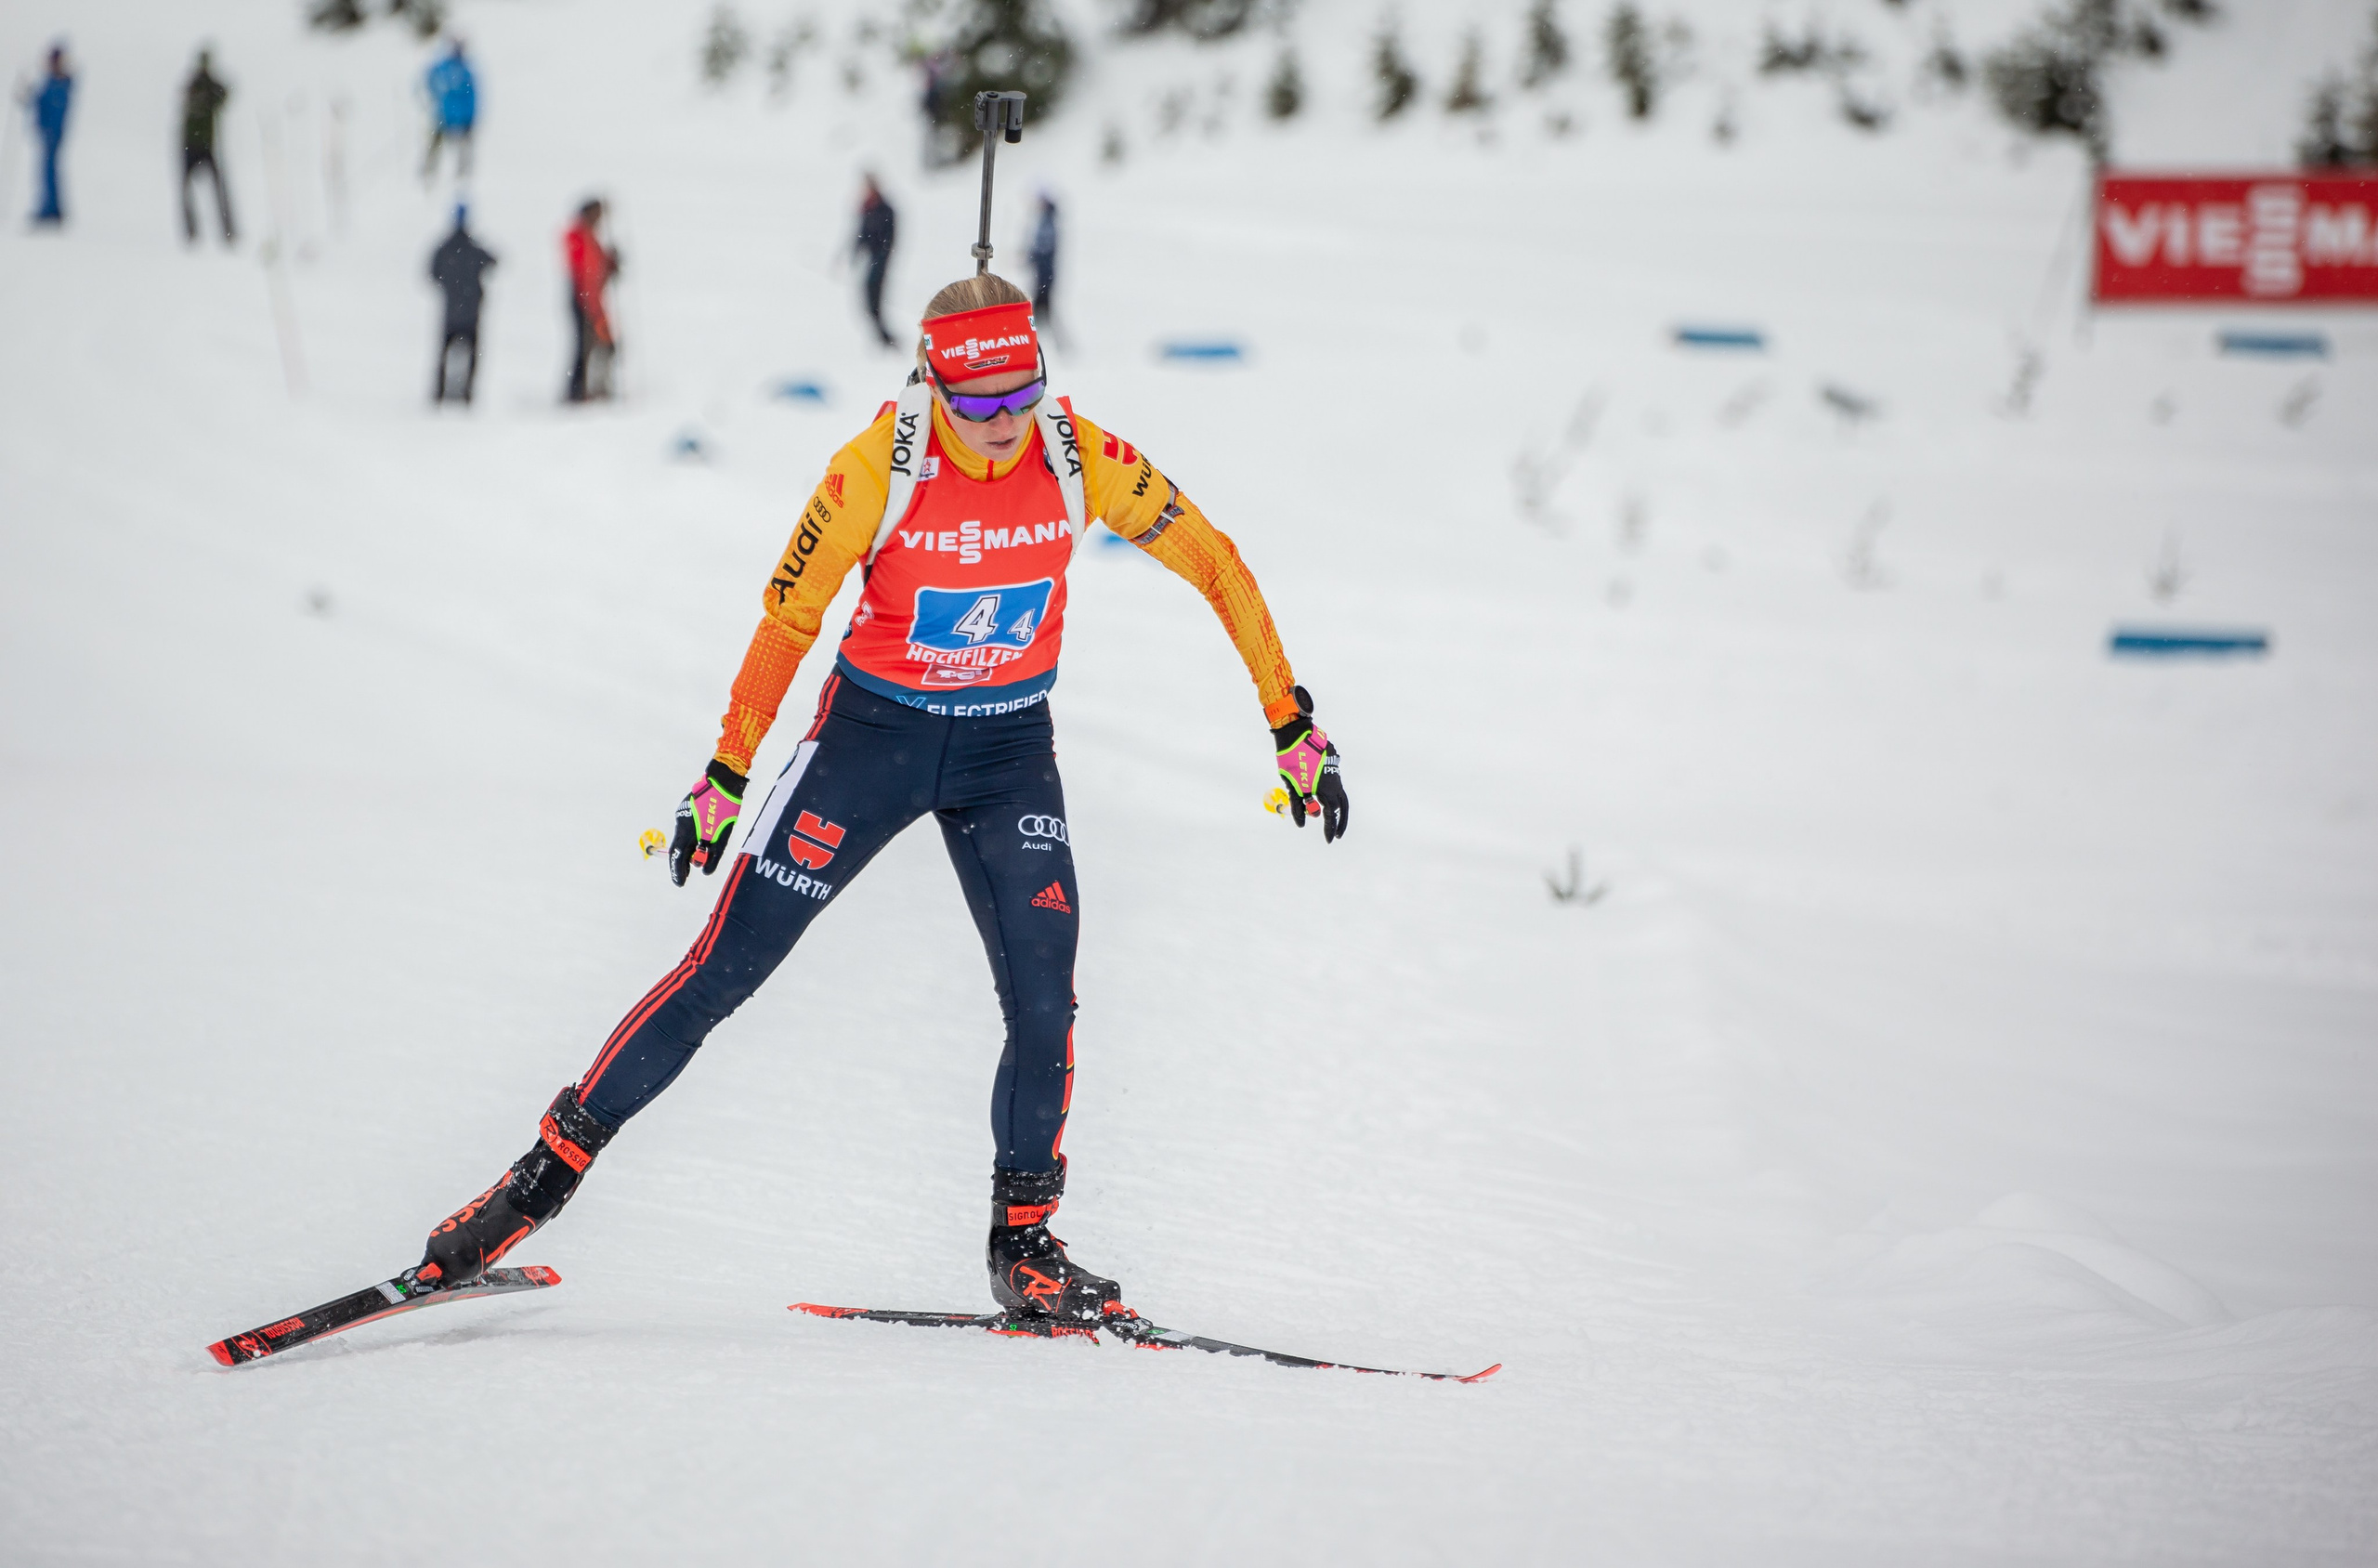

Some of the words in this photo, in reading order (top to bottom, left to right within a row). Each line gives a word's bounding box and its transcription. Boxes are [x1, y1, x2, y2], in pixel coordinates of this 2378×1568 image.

[2104, 185, 2378, 296] VIESSM
[941, 334, 1029, 359] VIESSMANN
[891, 412, 920, 477] JOKA
[1046, 413, 1083, 477] JOKA
[771, 512, 823, 607] Audi
[898, 519, 1072, 564] VIESSMANN
[951, 595, 1000, 645] 4
[1007, 608, 1036, 642] 4
[1299, 751, 1309, 788] LEKI
[705, 797, 717, 836] LEKI
[1022, 841, 1052, 852] Audi
[754, 856, 832, 901] WÜRTH
[1031, 897, 1071, 914] adidas
[557, 1143, 587, 1168] ROSSIG
[260, 1316, 305, 1339] ROSSIGNOL
